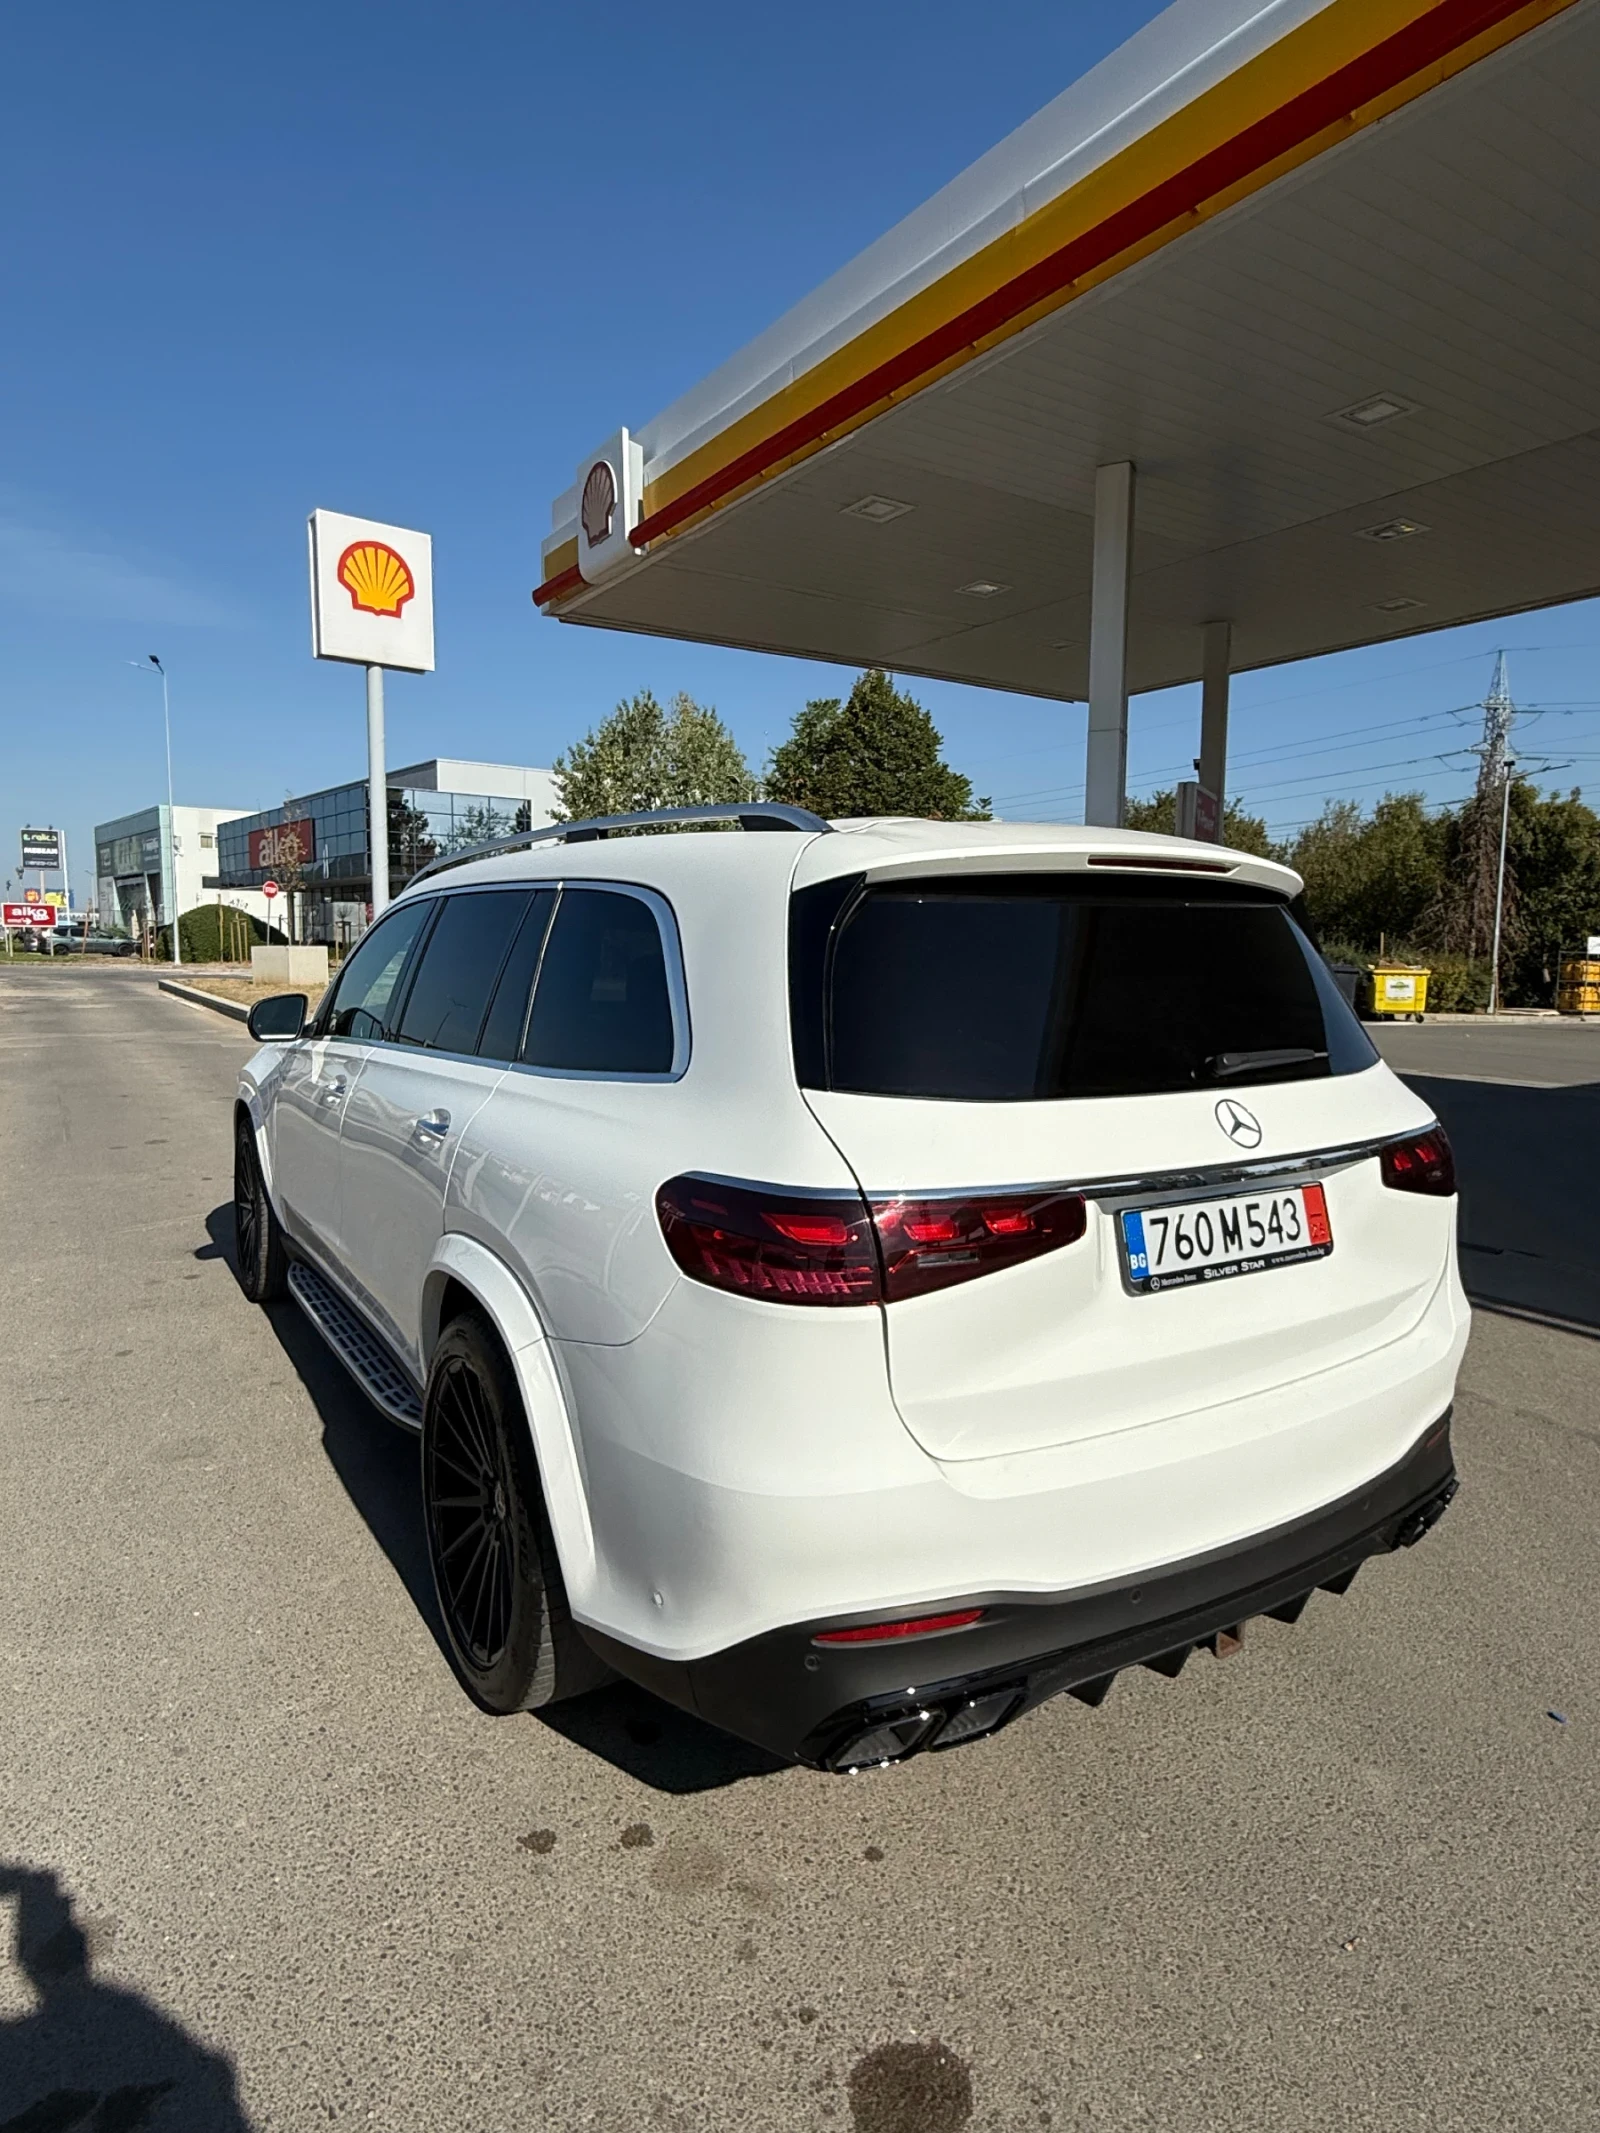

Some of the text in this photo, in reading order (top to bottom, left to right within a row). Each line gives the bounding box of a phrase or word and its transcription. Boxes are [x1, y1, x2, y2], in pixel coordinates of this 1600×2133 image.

[11, 907, 48, 916] aiko
[1149, 1197, 1301, 1266] 760M543
[1130, 1252, 1147, 1270] BG
[1203, 1265, 1239, 1279] SILVER
[1240, 1259, 1266, 1272] STAR
